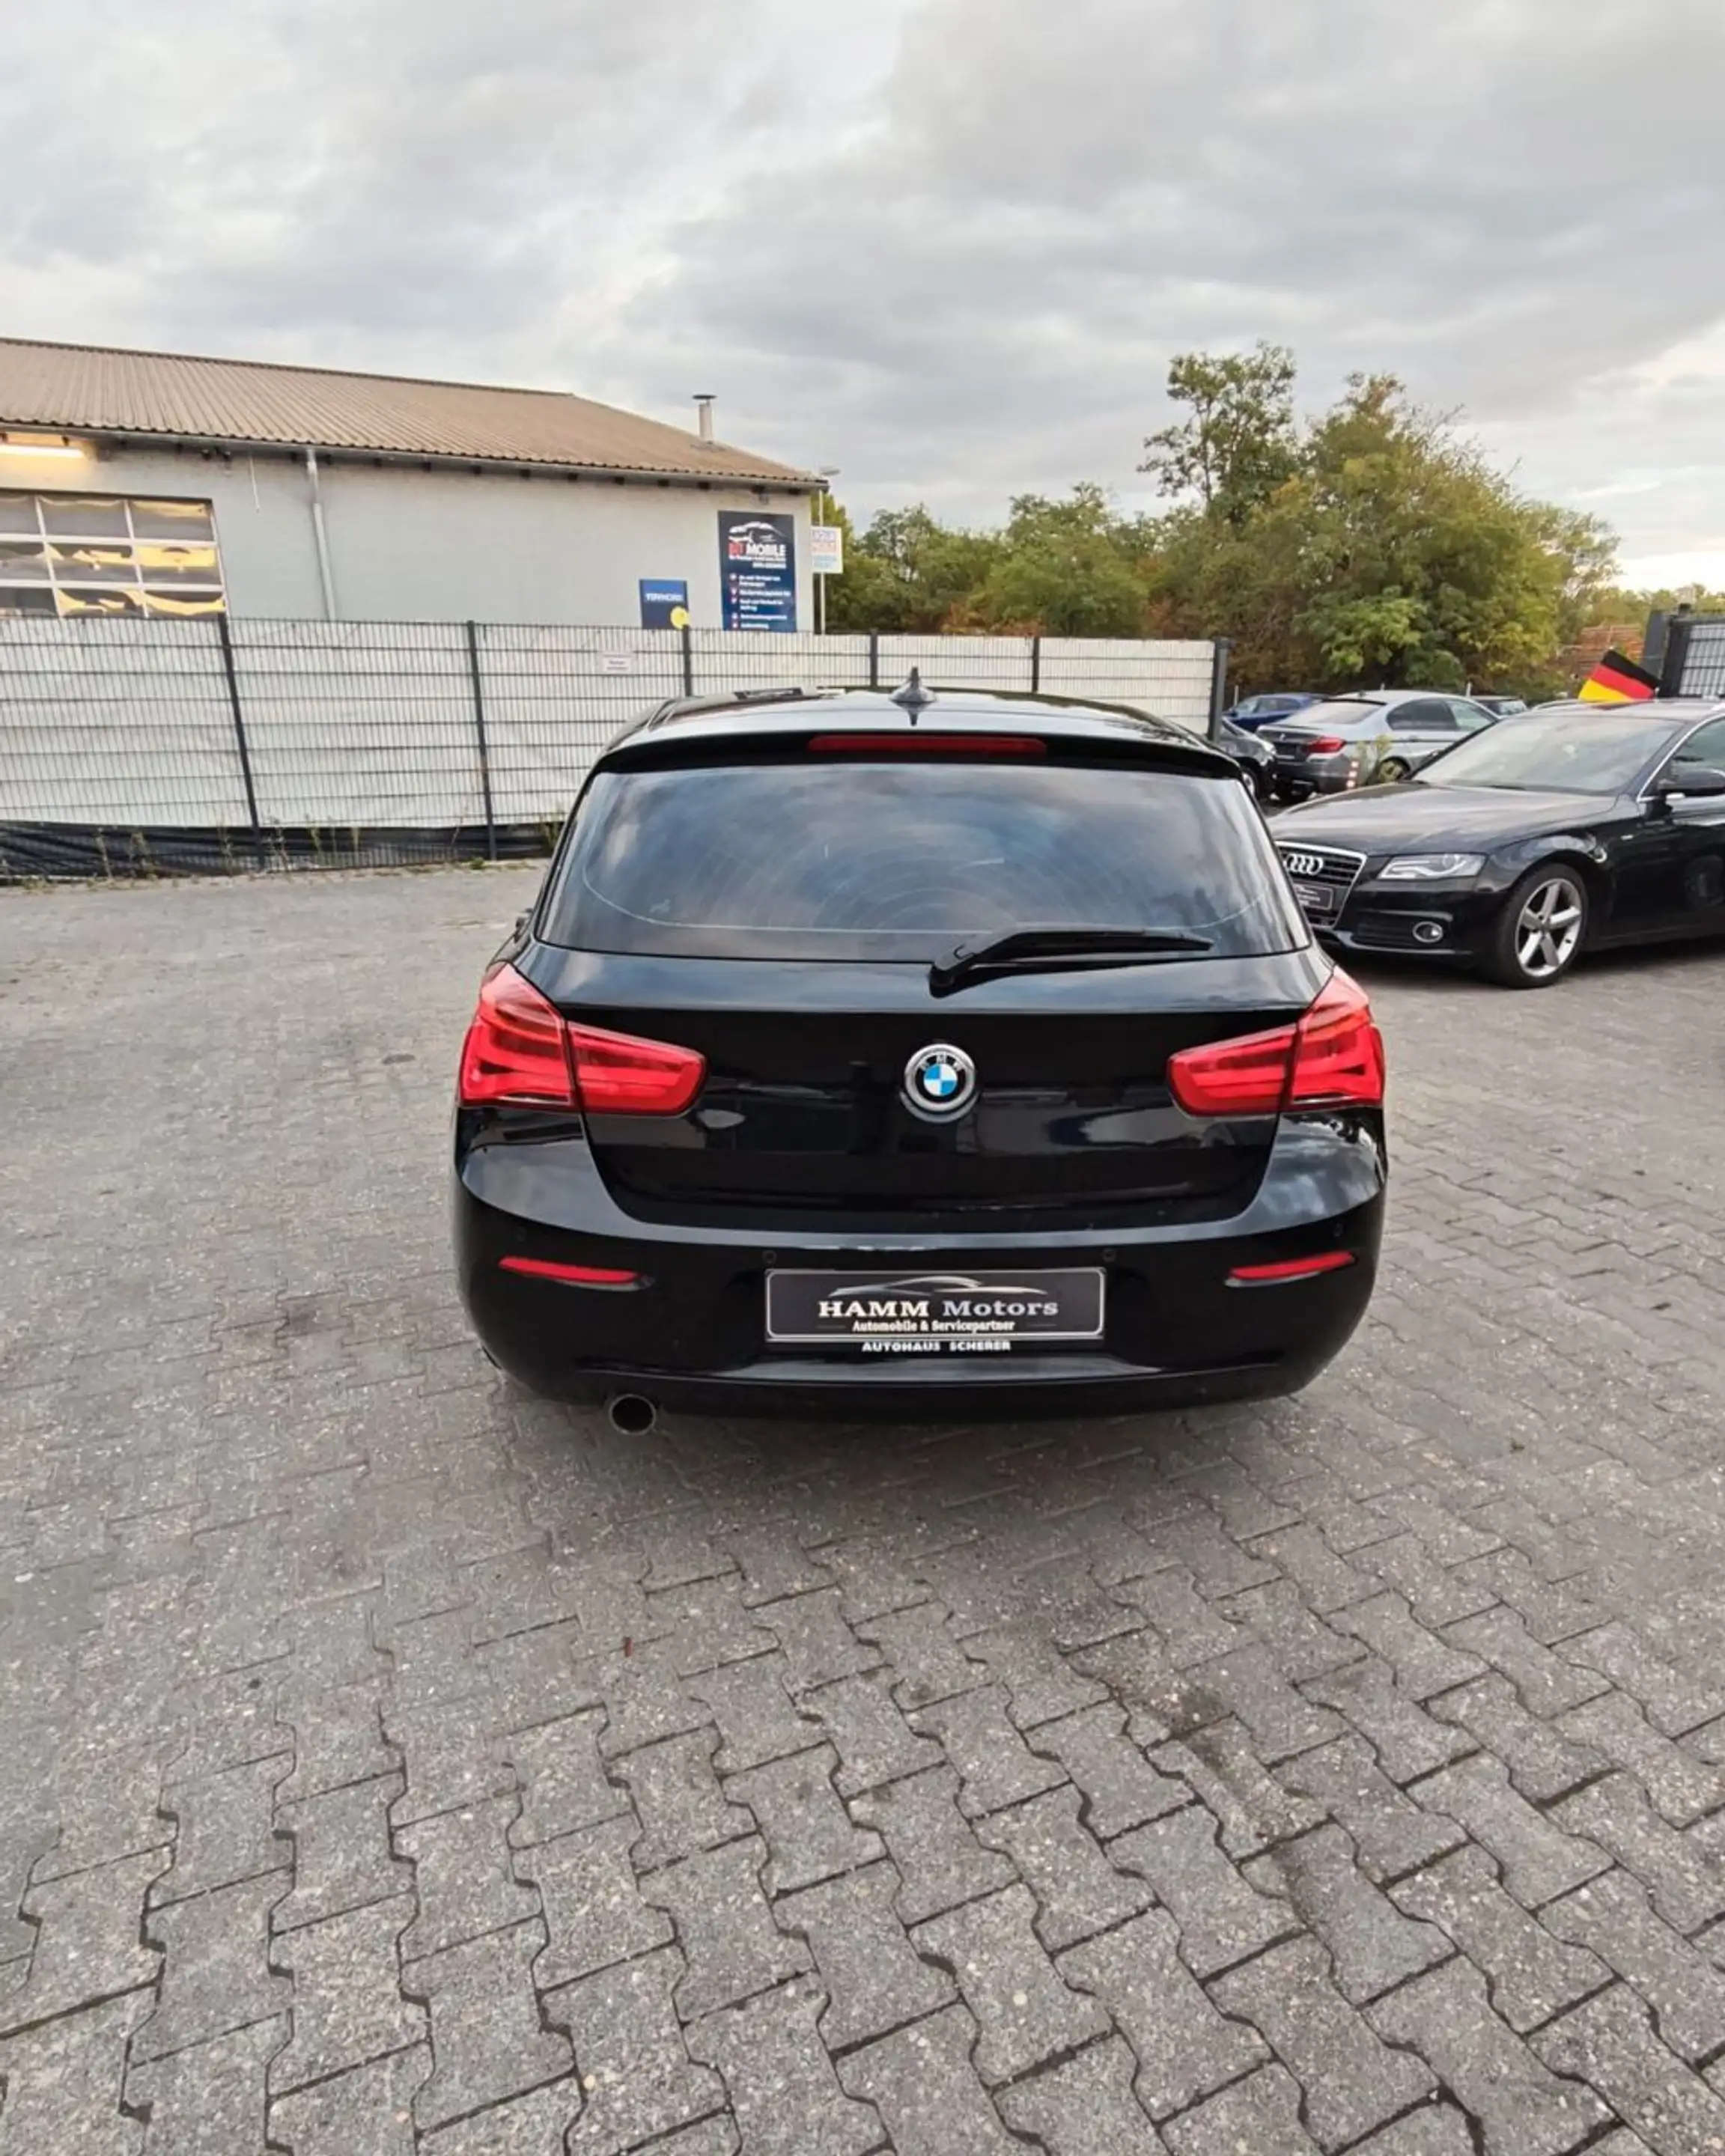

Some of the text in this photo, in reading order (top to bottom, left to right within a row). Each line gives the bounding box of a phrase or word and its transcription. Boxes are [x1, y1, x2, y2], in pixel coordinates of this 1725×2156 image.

[818, 1300, 1059, 1318] HAMM Motors
[852, 1320, 1015, 1333] Automobile & Servicepartner
[862, 1340, 1011, 1352] AUTOHAUS SCHERER
